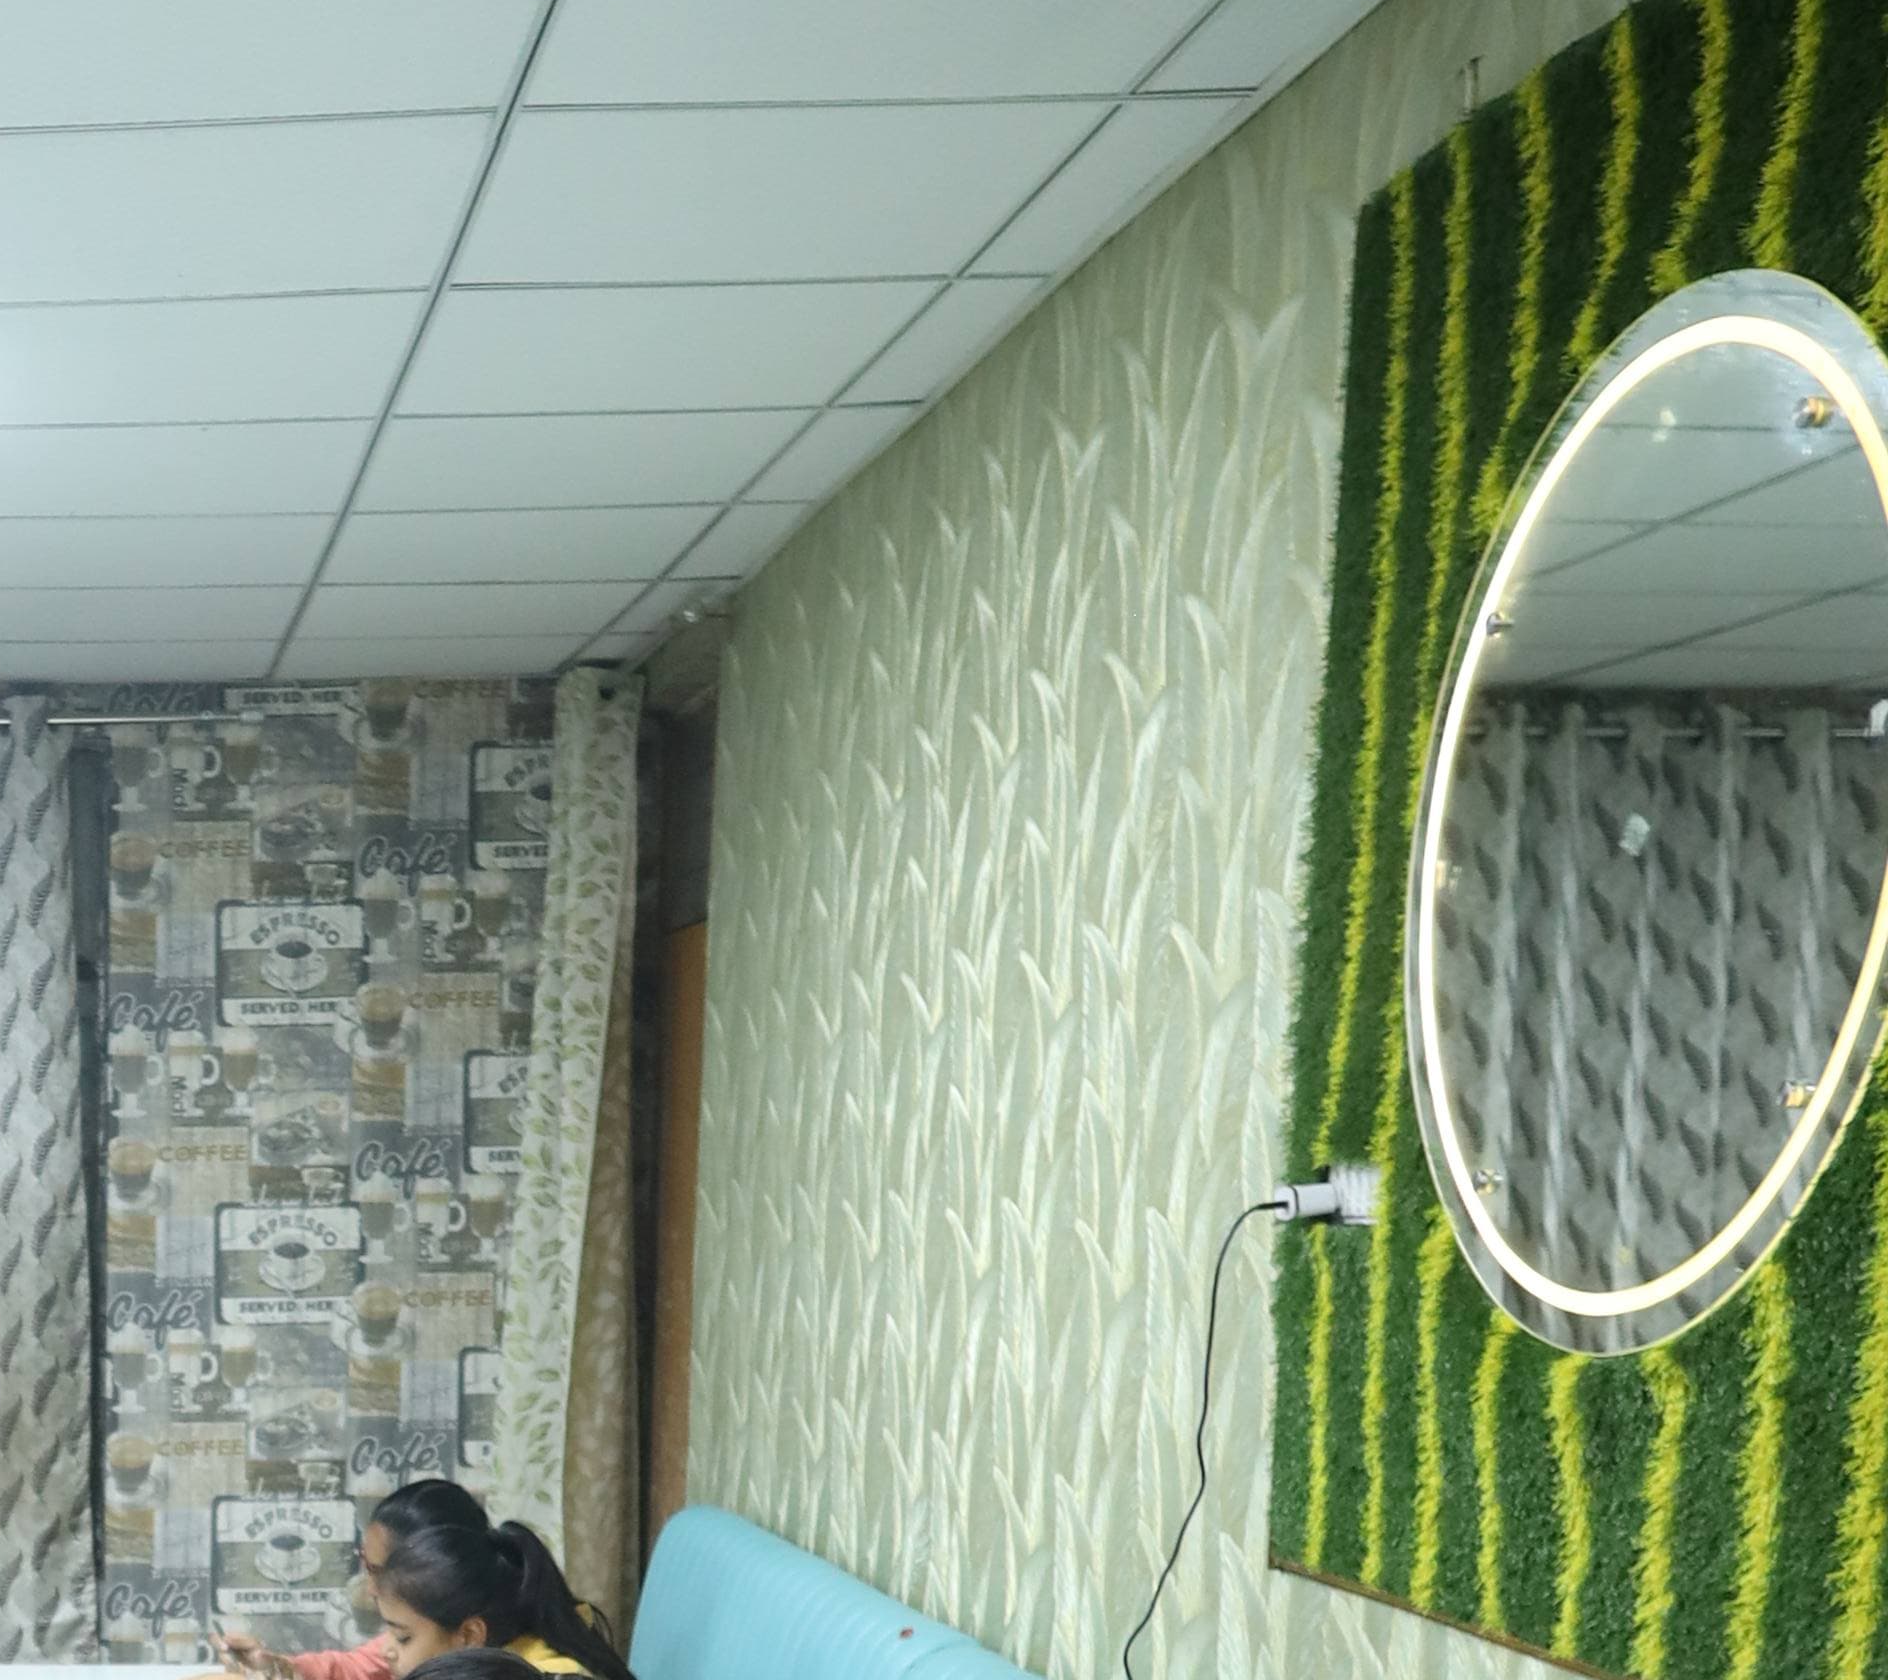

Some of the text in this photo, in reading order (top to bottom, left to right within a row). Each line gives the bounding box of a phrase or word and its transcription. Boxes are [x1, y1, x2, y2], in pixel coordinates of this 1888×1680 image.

[161, 840, 250, 858] COFFEE
[360, 832, 458, 897] Café
[250, 912, 340, 945] ESPRESSO
[241, 1001, 299, 1014] SERVED
[410, 991, 497, 1009] COFFEE
[109, 989, 205, 1053] Café
[159, 1144, 248, 1162] COFFEE
[355, 1137, 453, 1201] Café
[248, 1216, 338, 1247] ESPRESSO
[239, 1301, 297, 1313] SERVED
[403, 1289, 492, 1308] COFFEE
[107, 1289, 204, 1351] Café
[158, 1439, 243, 1456] COFFEE
[350, 1431, 447, 1484] Café
[244, 1507, 333, 1540] ESPRESSO
[105, 1580, 199, 1639] Café
[234, 1591, 292, 1604] SERVED
